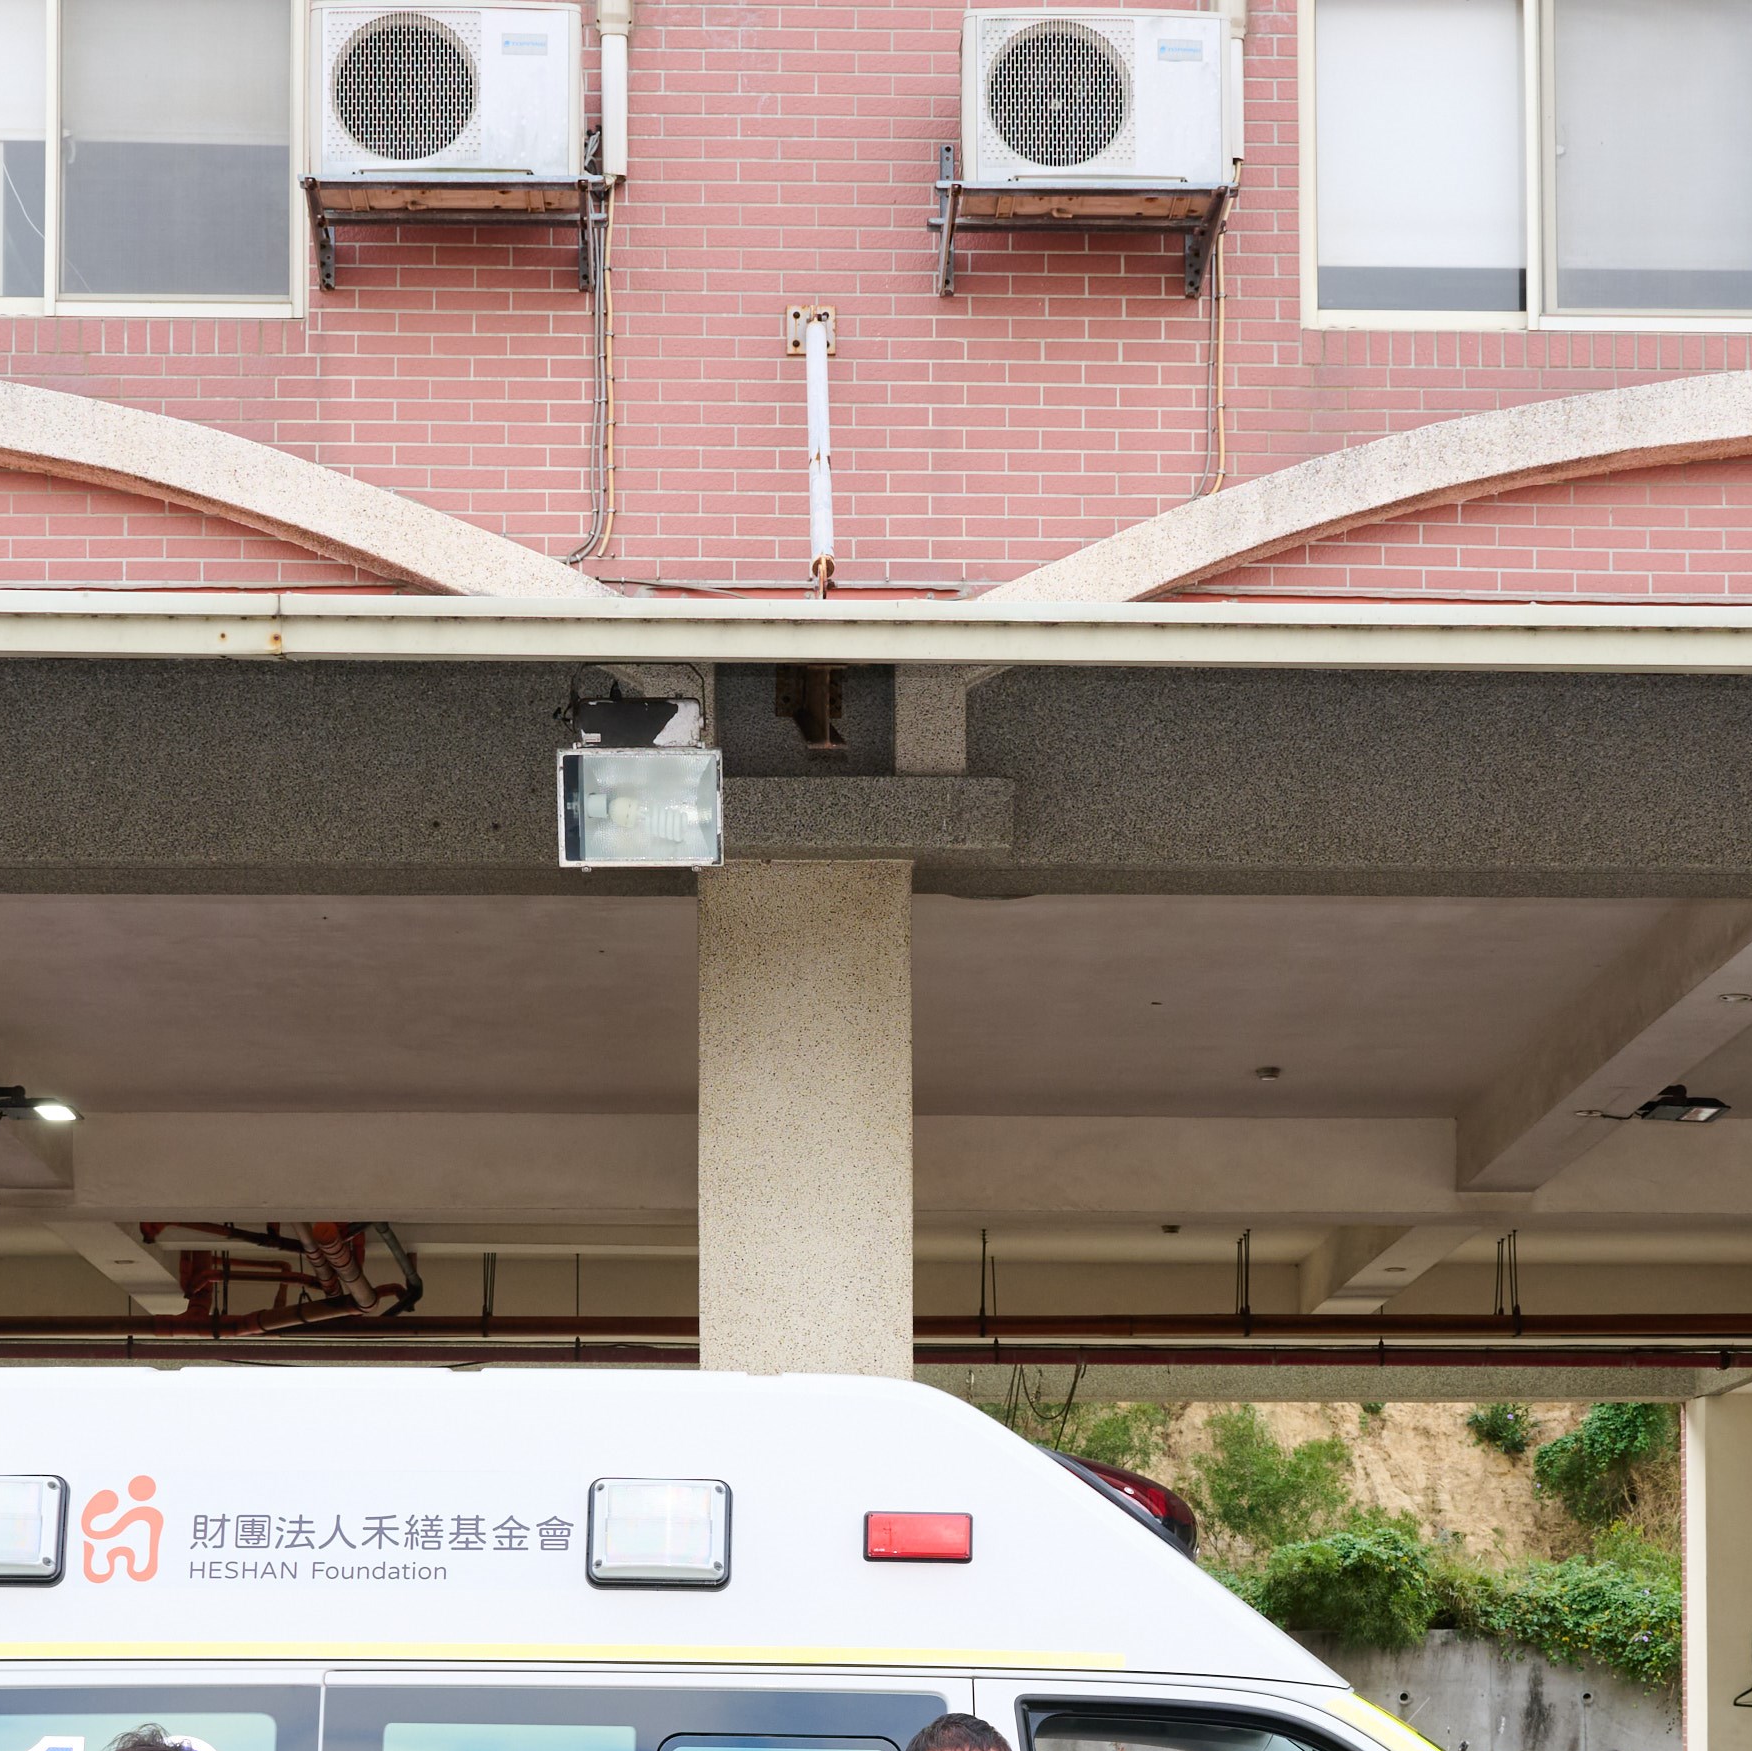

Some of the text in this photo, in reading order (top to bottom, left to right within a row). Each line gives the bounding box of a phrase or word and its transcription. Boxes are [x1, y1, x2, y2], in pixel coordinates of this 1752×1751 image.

[191, 1513, 575, 1552] 財團法人禾繕基金會
[189, 1560, 447, 1581] HESHAN Foundation
